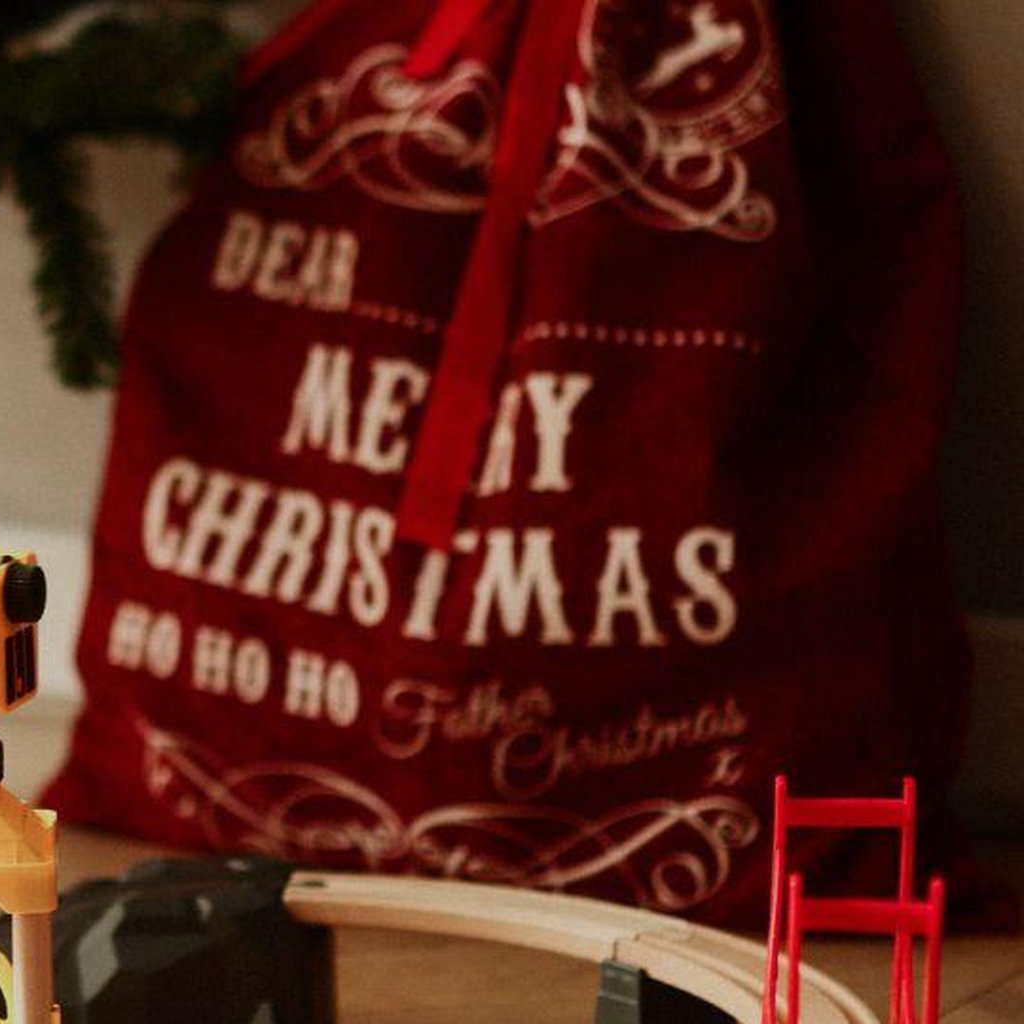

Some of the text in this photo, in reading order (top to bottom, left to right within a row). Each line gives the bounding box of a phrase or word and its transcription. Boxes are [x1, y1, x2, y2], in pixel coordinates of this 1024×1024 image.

[142, 457, 738, 646] CHRISTMAS
[107, 601, 360, 728] HO HO HO
